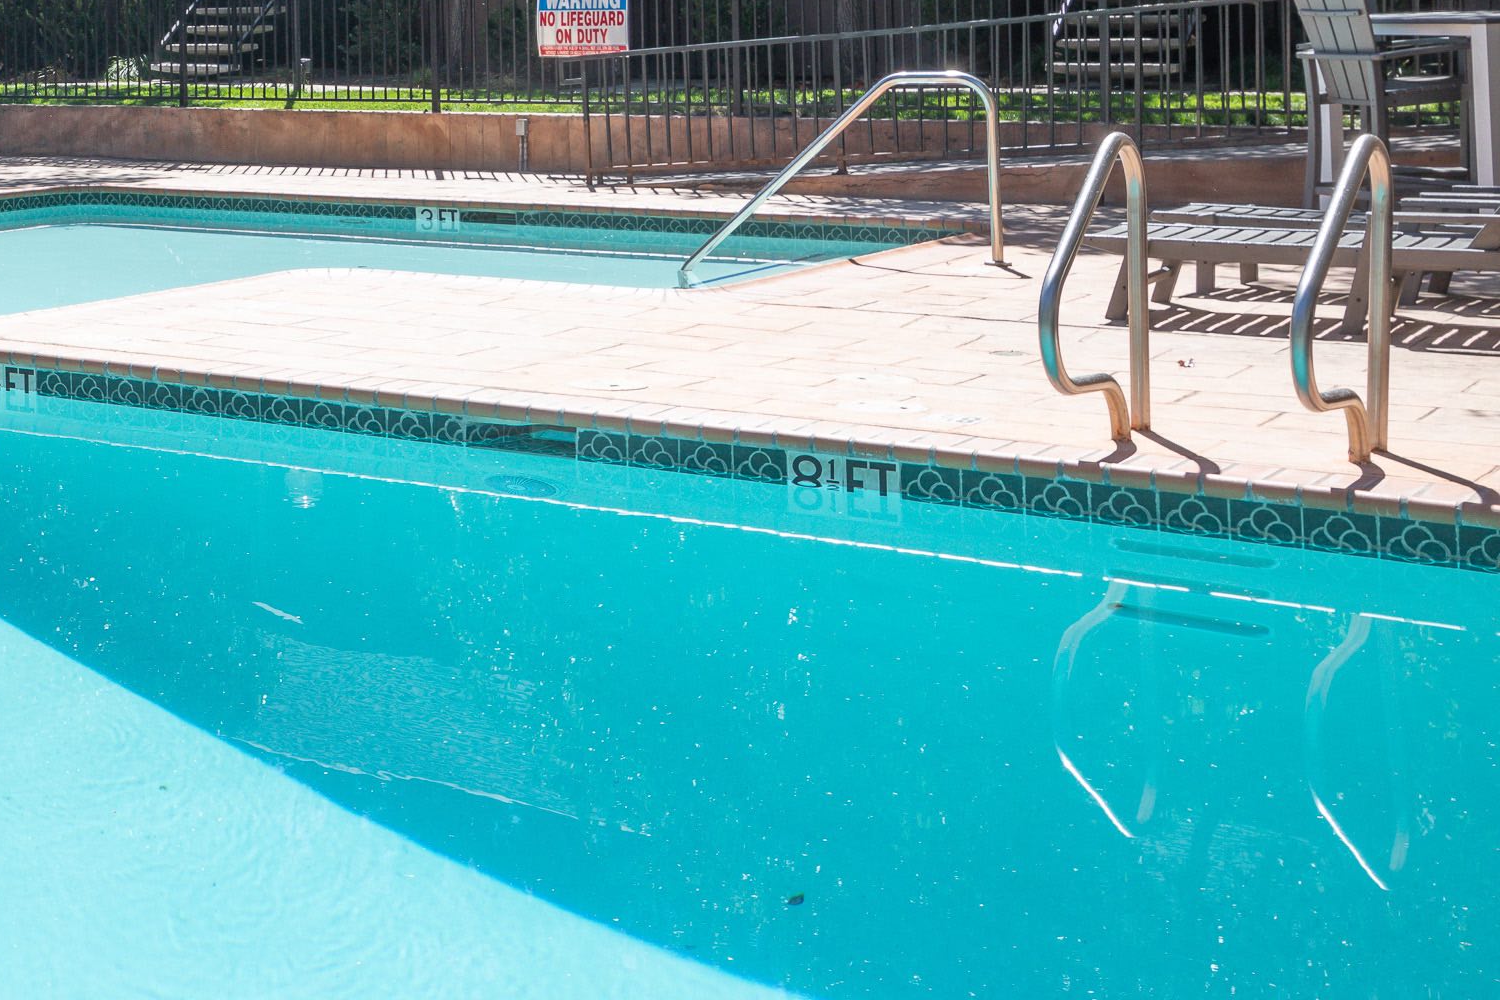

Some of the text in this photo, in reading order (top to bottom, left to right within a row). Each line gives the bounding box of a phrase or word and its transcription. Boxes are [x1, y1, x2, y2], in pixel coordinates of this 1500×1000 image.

[539, 11, 625, 27] NO LIFEGUARD
[556, 28, 608, 44] ON DUTY
[438, 208, 458, 222] FT
[5, 366, 35, 394] FT
[846, 459, 897, 497] FT
